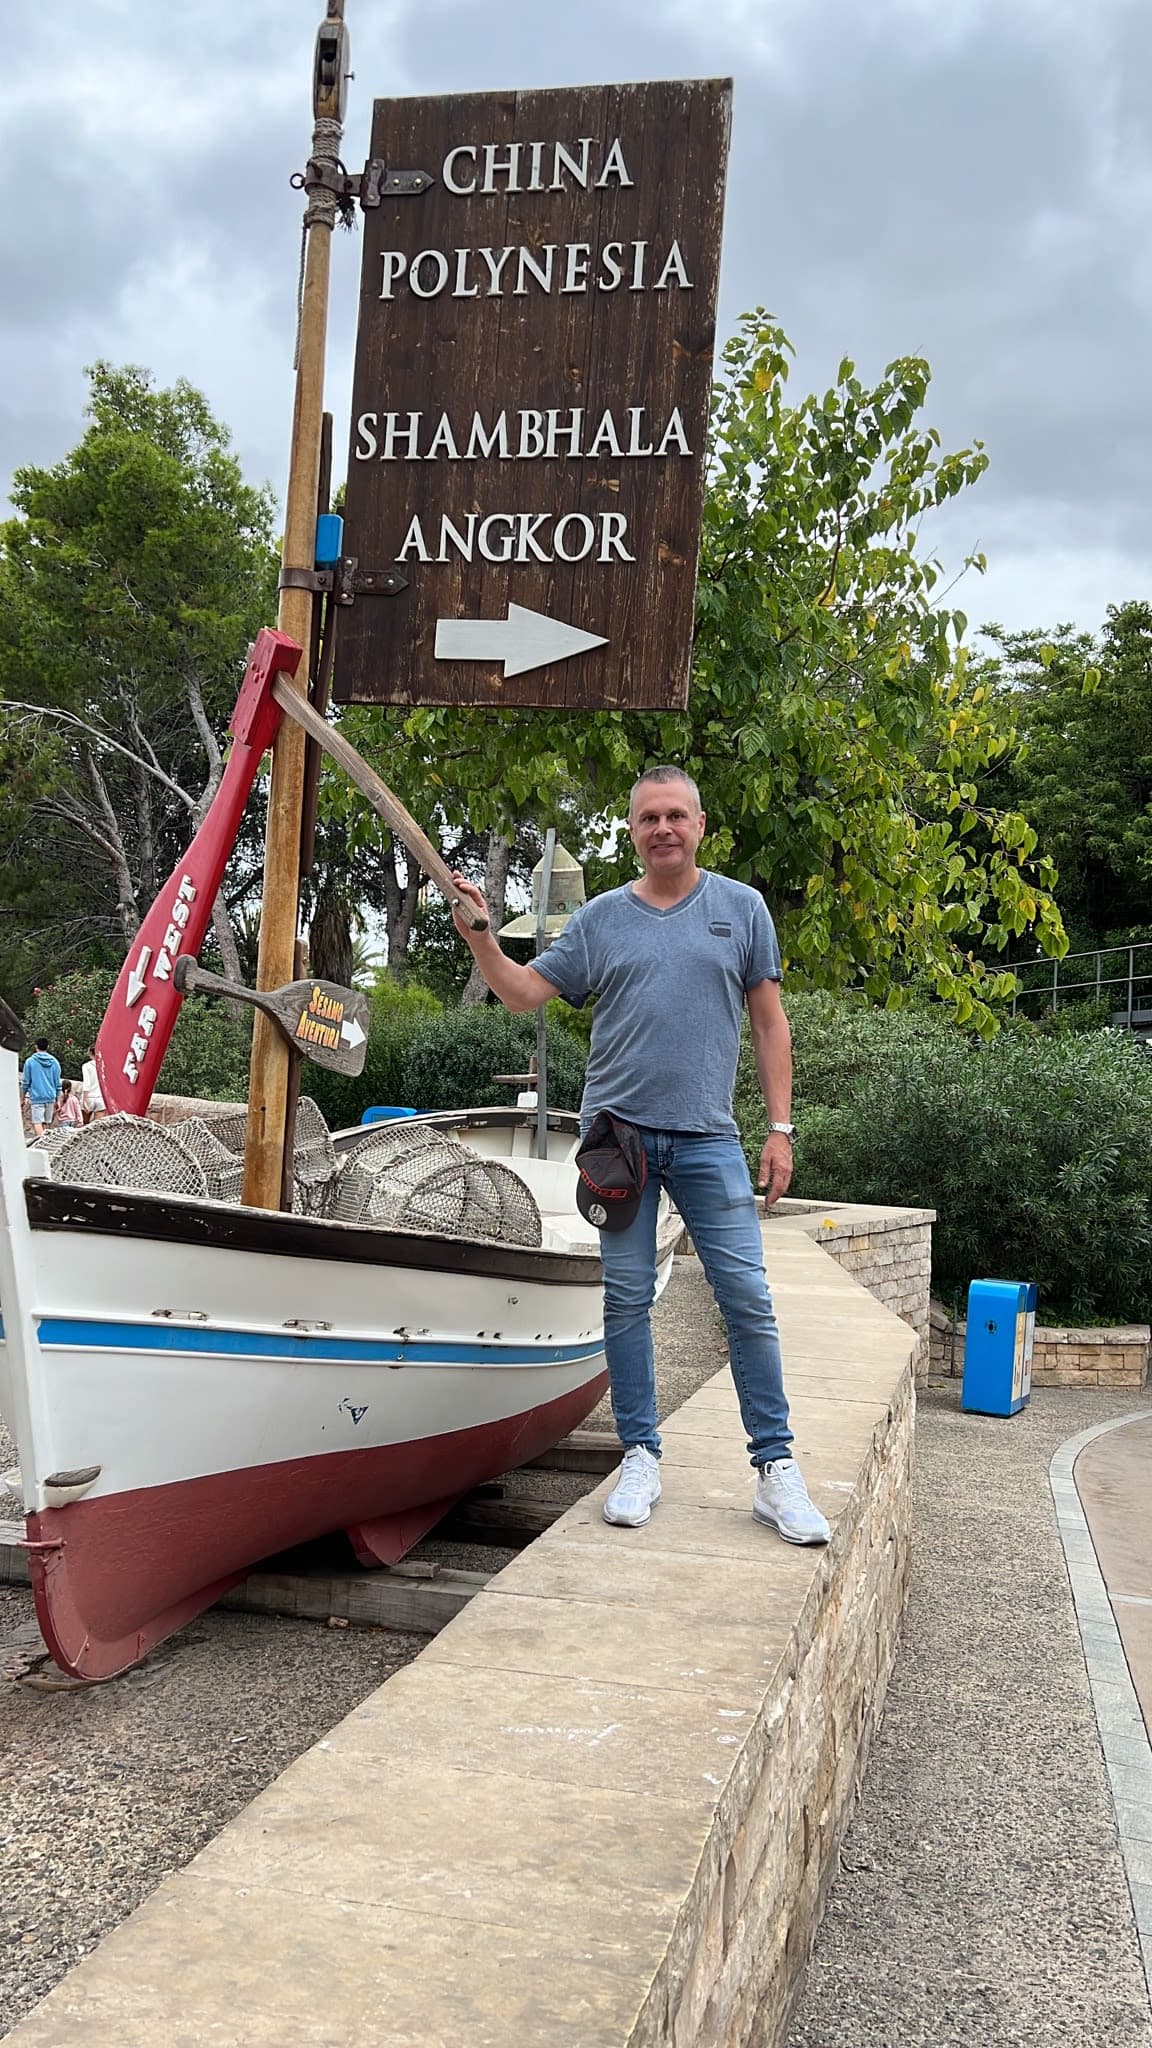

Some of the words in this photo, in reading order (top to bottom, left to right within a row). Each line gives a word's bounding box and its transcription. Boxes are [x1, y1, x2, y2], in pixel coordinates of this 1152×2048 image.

[442, 138, 634, 195] CHINA
[379, 240, 693, 299] POLYNESIA
[355, 407, 693, 460] SHAMBHALA
[395, 512, 636, 562] ANGKOR
[122, 1005, 157, 1084] FAR
[153, 874, 197, 980] WEST
[296, 1010, 340, 1051] AVENTURA
